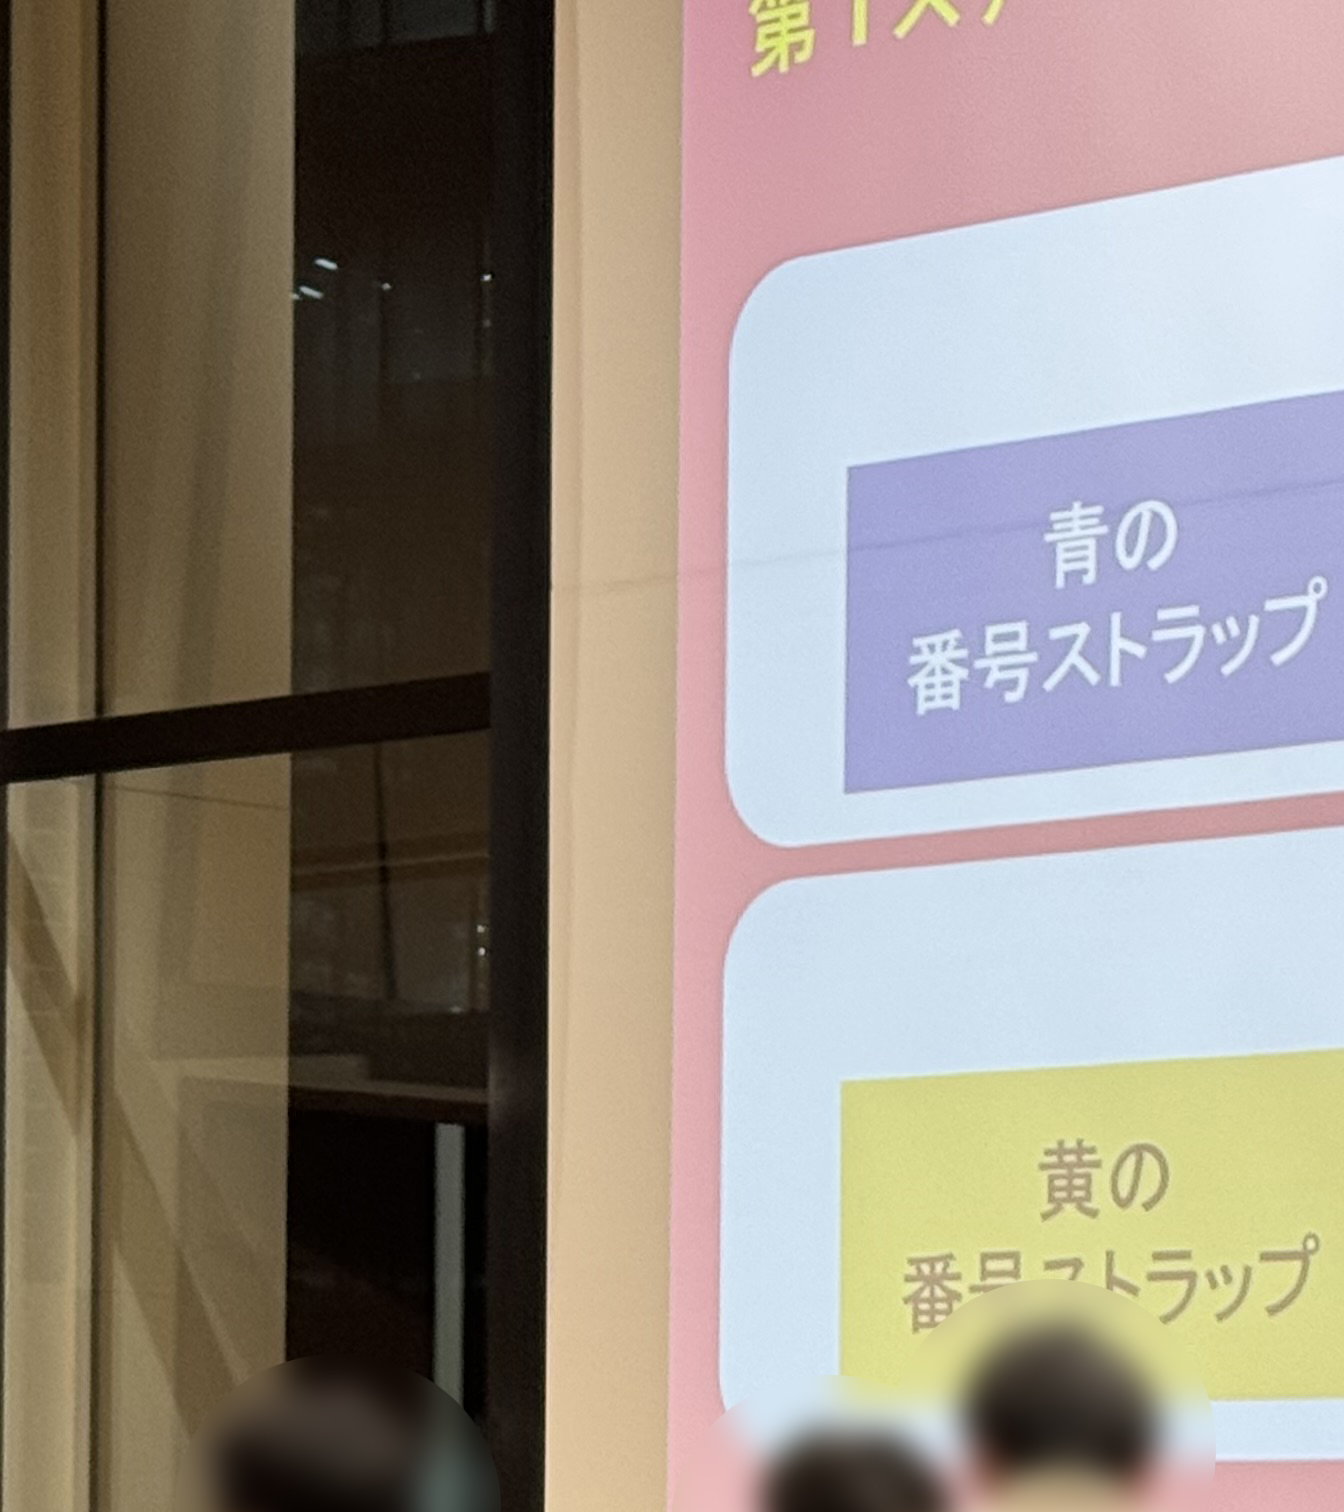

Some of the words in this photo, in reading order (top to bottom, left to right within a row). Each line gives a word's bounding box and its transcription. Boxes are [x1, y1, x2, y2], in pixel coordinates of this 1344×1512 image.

[1043, 499, 1179, 589] 青の
[907, 575, 1329, 716] 番号ストラップ
[1037, 1138, 1171, 1222] 黄の
